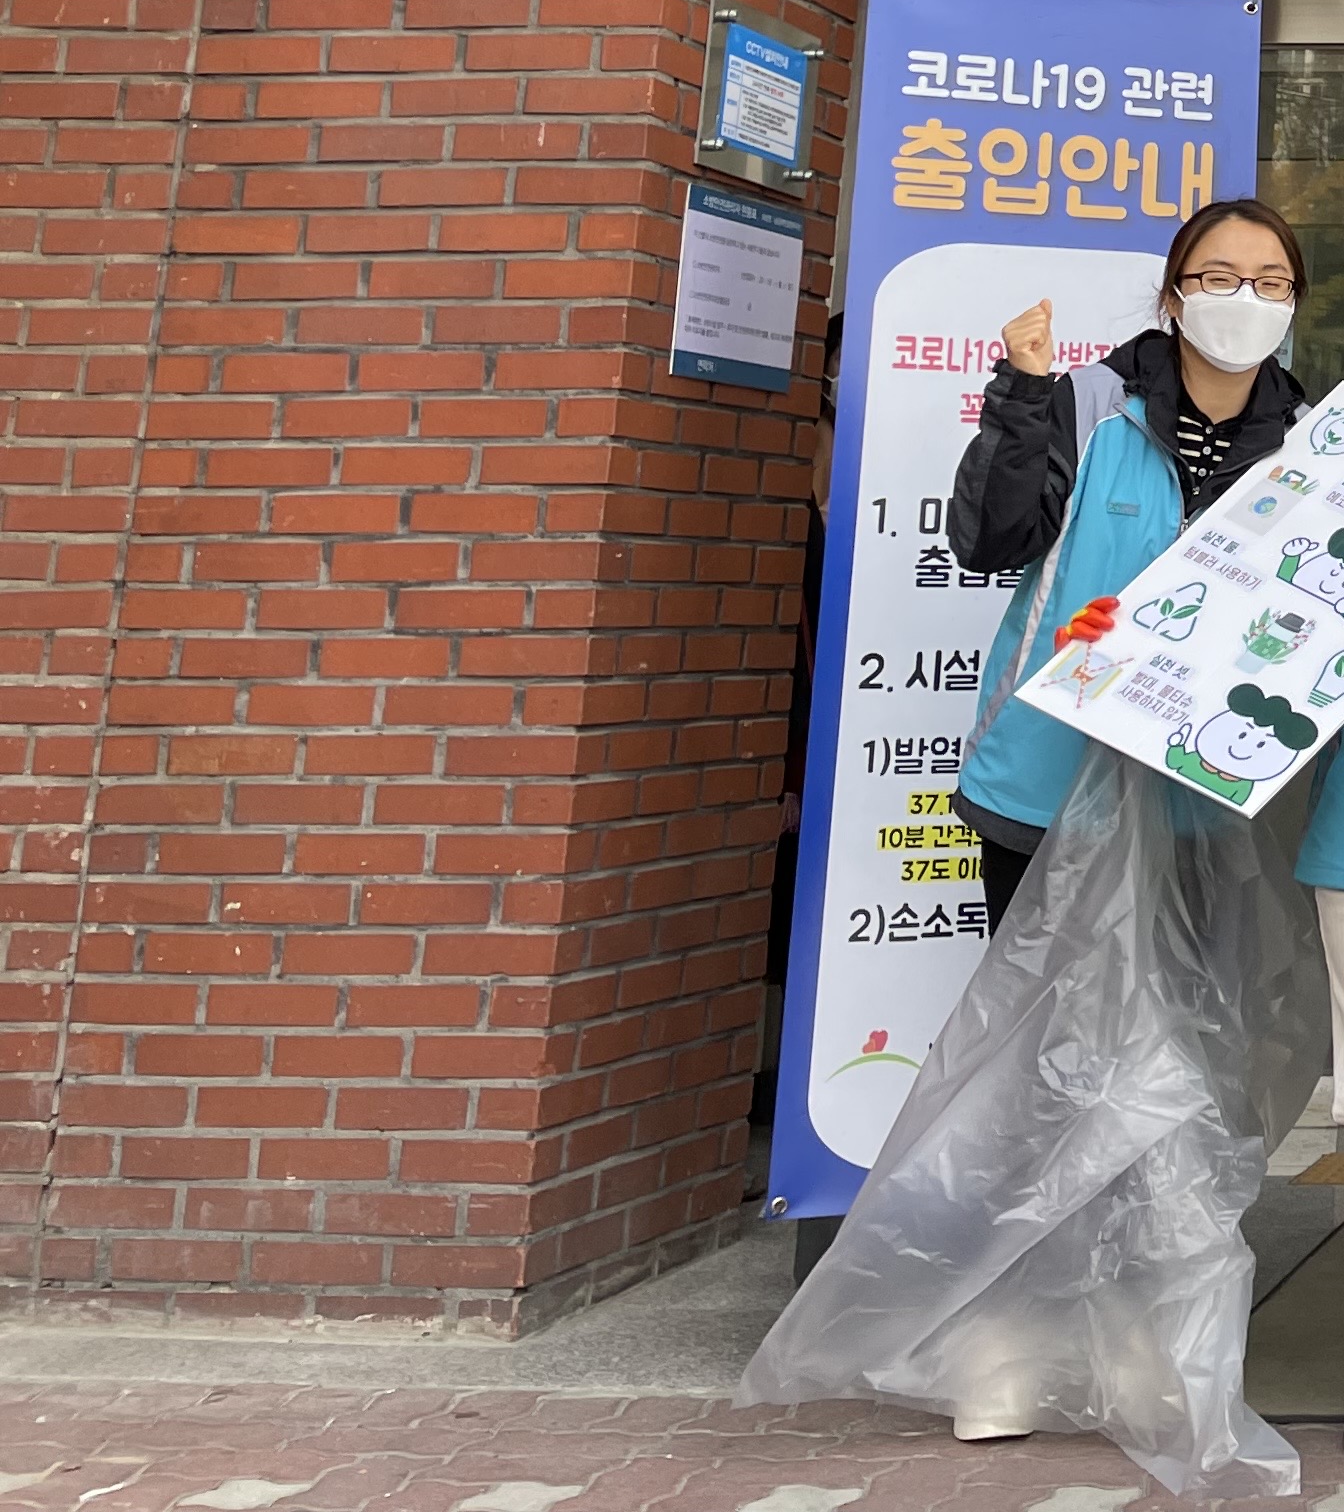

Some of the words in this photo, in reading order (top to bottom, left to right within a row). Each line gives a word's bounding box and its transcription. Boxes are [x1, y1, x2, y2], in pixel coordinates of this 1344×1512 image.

[901, 49, 1107, 112] 코로나19
[1122, 67, 1215, 122] 관련
[891, 117, 1215, 223] 출입안내
[872, 497, 897, 537] 1.
[1201, 530, 1227, 548] 실천
[1184, 546, 1220, 569] 텀블러
[1215, 562, 1262, 591] 사용하기
[858, 652, 894, 693] 2.
[905, 649, 980, 692] 시설
[1149, 654, 1177, 673] 실천
[1118, 685, 1165, 714] 사용하지
[1161, 706, 1190, 725] 않기
[878, 826, 925, 849] 10분
[901, 860, 950, 881] 37도
[958, 857, 984, 880] 이
